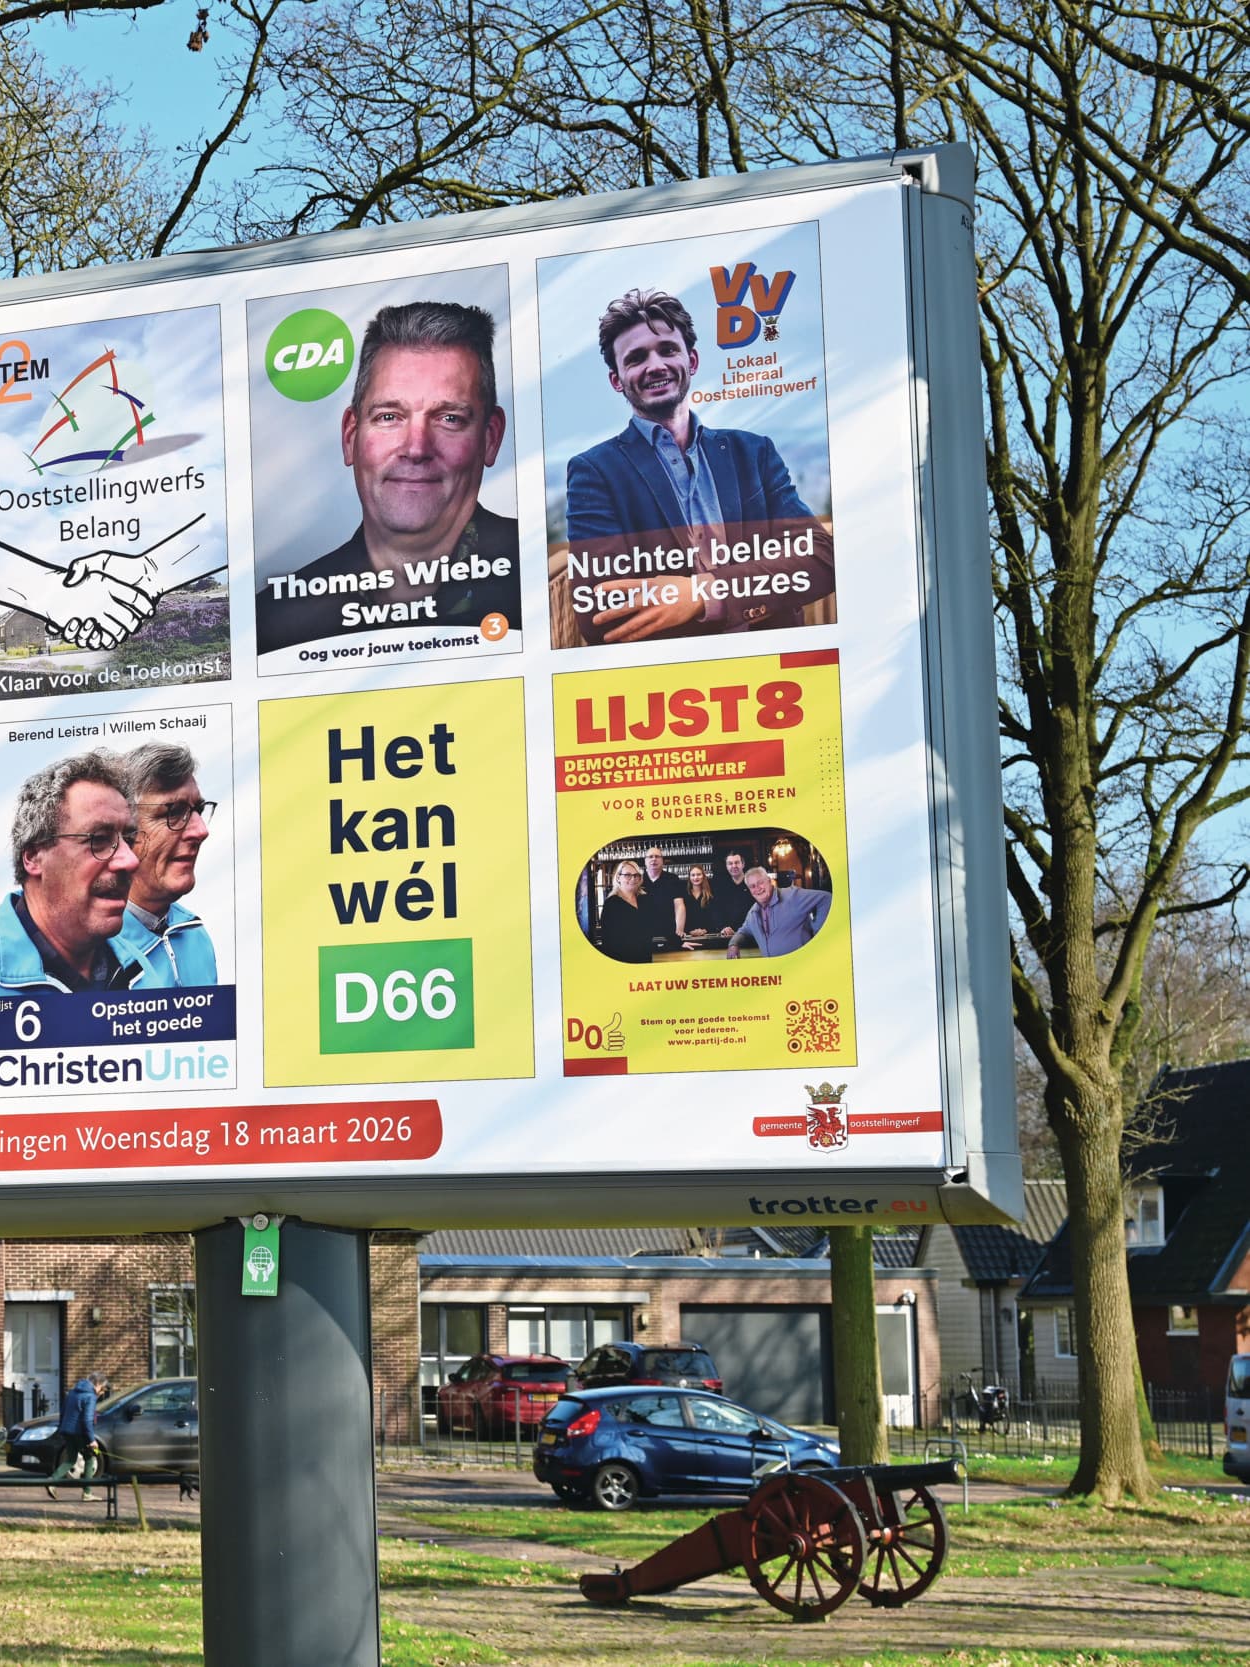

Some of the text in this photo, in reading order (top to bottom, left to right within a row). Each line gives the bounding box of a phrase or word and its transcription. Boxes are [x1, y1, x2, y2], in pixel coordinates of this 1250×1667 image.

[273, 339, 345, 372] CDA
[727, 352, 777, 370] Lokaal
[722, 366, 783, 385] Liberaal
[691, 376, 817, 404] Ooststellingwerf
[60, 515, 140, 542] Belang
[566, 529, 815, 580] Nuchter beleid
[267, 554, 512, 600] Thomas Wiebe
[572, 568, 811, 614] Sterke keuzes
[341, 595, 438, 627] Swart
[487, 618, 502, 636] 3
[298, 634, 479, 663] Oog voor jouw toekomst
[48, 672, 92, 689] voor
[98, 668, 120, 684] de
[126, 657, 222, 681] Toekomst
[8, 728, 53, 742] Berend
[58, 725, 99, 739] Leistra
[110, 721, 156, 734] Willem
[159, 714, 207, 730] Schaaij
[328, 723, 456, 784] Het
[564, 749, 707, 773] DEMOCRATISCH
[564, 761, 747, 787] OOSTSTELLINGWERF
[602, 787, 797, 811] VOOR BURGERS, BOEREN
[635, 802, 768, 821] & ONDERNEMERS
[329, 798, 456, 854] kan
[328, 860, 457, 925] wél
[335, 967, 456, 1024] D66
[629, 975, 782, 993] LAAT UW STEM HOREN!
[91, 993, 214, 1020] Opstaan voor
[640, 1018, 663, 1026] Stem
[698, 1015, 725, 1025] goede
[728, 1014, 770, 1022] toekomst
[15, 1000, 41, 1042] 6
[112, 1014, 203, 1037] het goede
[668, 1036, 747, 1046] www.partij-do.nl
[76, 1122, 210, 1155] Woensdag
[220, 1121, 250, 1147] 18
[259, 1121, 338, 1146] maart
[346, 1116, 413, 1143] 2026
[760, 1117, 920, 1133] gemeente ooststellingwerf
